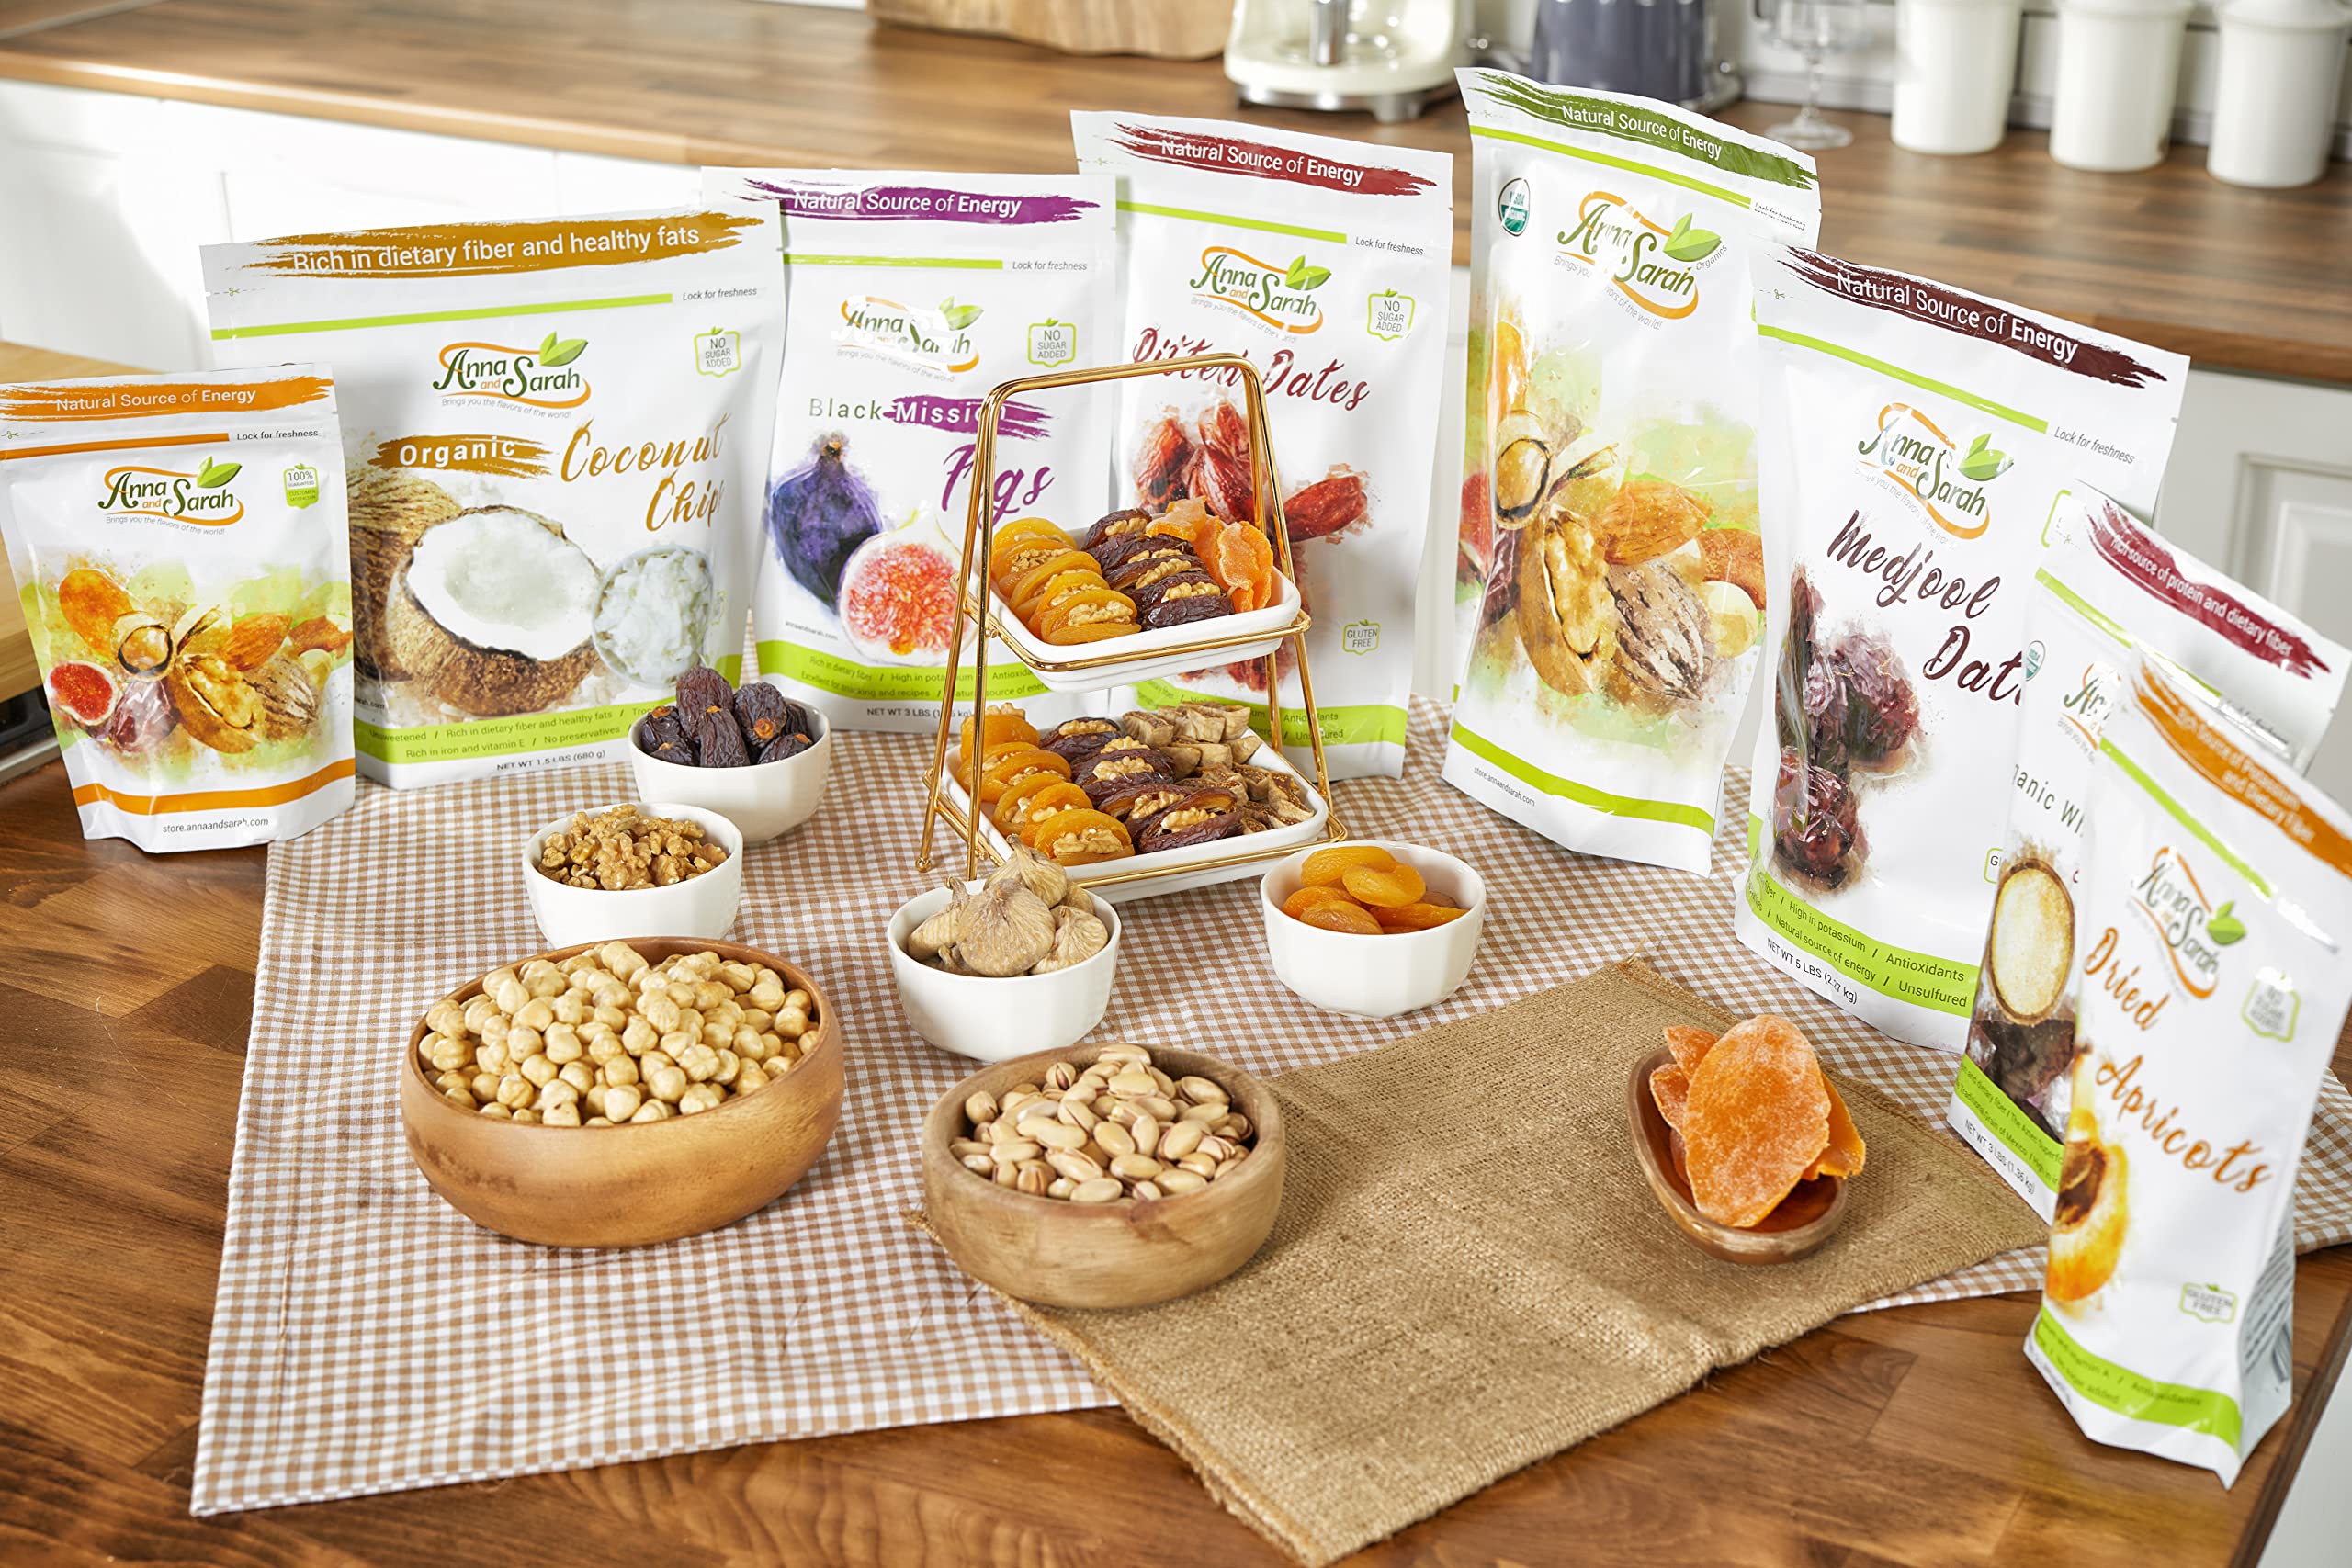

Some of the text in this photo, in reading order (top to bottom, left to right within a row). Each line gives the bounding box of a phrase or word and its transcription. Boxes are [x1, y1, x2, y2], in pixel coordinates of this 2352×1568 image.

[1563, 105, 1722, 161] Natural Source of Energy
[1160, 140, 1364, 186] Natural Source of Energy
[793, 191, 1022, 219] Natural Source of Energy
[293, 225, 699, 271] Rich in dietary fiber and healthy fats
[1355, 236, 1424, 256] Lock for freshness
[1696, 244, 1728, 271] Organics
[1012, 260, 1087, 272] Lock for freshness
[1614, 231, 1695, 296] Sarah
[683, 288, 757, 301] Lock for freshness
[1190, 254, 1317, 316] Anna and Sarah
[1377, 311, 1405, 324] SUGAR
[1384, 300, 1400, 313] NO
[1838, 272, 2079, 363] Natural Source of Energy
[1044, 329, 1061, 341] NO
[1376, 321, 1402, 333] ADDED
[705, 348, 731, 359] SUGAR
[710, 337, 726, 349] NO
[1037, 340, 1067, 351] SUGAR
[1037, 349, 1067, 359] ADDED
[433, 349, 580, 398] Anna and Sarah
[706, 357, 732, 368] ADDED
[1262, 349, 1370, 412] Dates
[56, 389, 256, 412] Natural Source of Energy
[809, 398, 883, 421] Black
[237, 429, 319, 441] Lock for freshness
[561, 413, 731, 482] Coconut
[2053, 426, 2135, 465] Lock for freshness
[400, 436, 516, 468] Organic
[1858, 416, 1986, 516] Anna and Sarah
[288, 470, 314, 482] 100%
[97, 471, 233, 517] Anna and Sarah
[1826, 509, 2001, 619] Medjool
[2128, 547, 2158, 576] source
[2157, 566, 2171, 582] of
[2166, 572, 2205, 604] protein
[2203, 593, 2228, 618] and
[2226, 607, 2267, 644] dietary
[2265, 628, 2294, 656] fiber
[1346, 628, 1378, 639] GLUTEN
[1352, 637, 1372, 649] FREE
[447, 728, 469, 738] Rich
[470, 727, 480, 737] in
[481, 724, 514, 736] dietary
[516, 720, 537, 730] fiber
[539, 718, 557, 728] and
[559, 715, 593, 727] healthy
[595, 710, 613, 721] fats
[867, 707, 931, 717] NET WT 3 LBS
[406, 749, 427, 759] Rich
[441, 746, 459, 757] iron
[462, 743, 480, 754] and
[481, 740, 516, 753] vitamin
[519, 738, 526, 747] E
[544, 736, 558, 744] No
[560, 726, 620, 743] preservatives
[496, 762, 515, 771] NET
[1474, 766, 1535, 807] store.annaandsarah.com
[1789, 901, 1965, 982] High in potassium Antioxidants
[1767, 937, 1781, 955] NET
[1781, 950, 1794, 964] WT
[1795, 958, 1802, 969] 5
[1803, 962, 1823, 979] LBS
[1842, 986, 1859, 1005] kg)
[1775, 914, 1968, 1008] Natural source of energy Unsulfured
[2083, 927, 2170, 1031] Dried
[2096, 1055, 2273, 1193] Apricots
